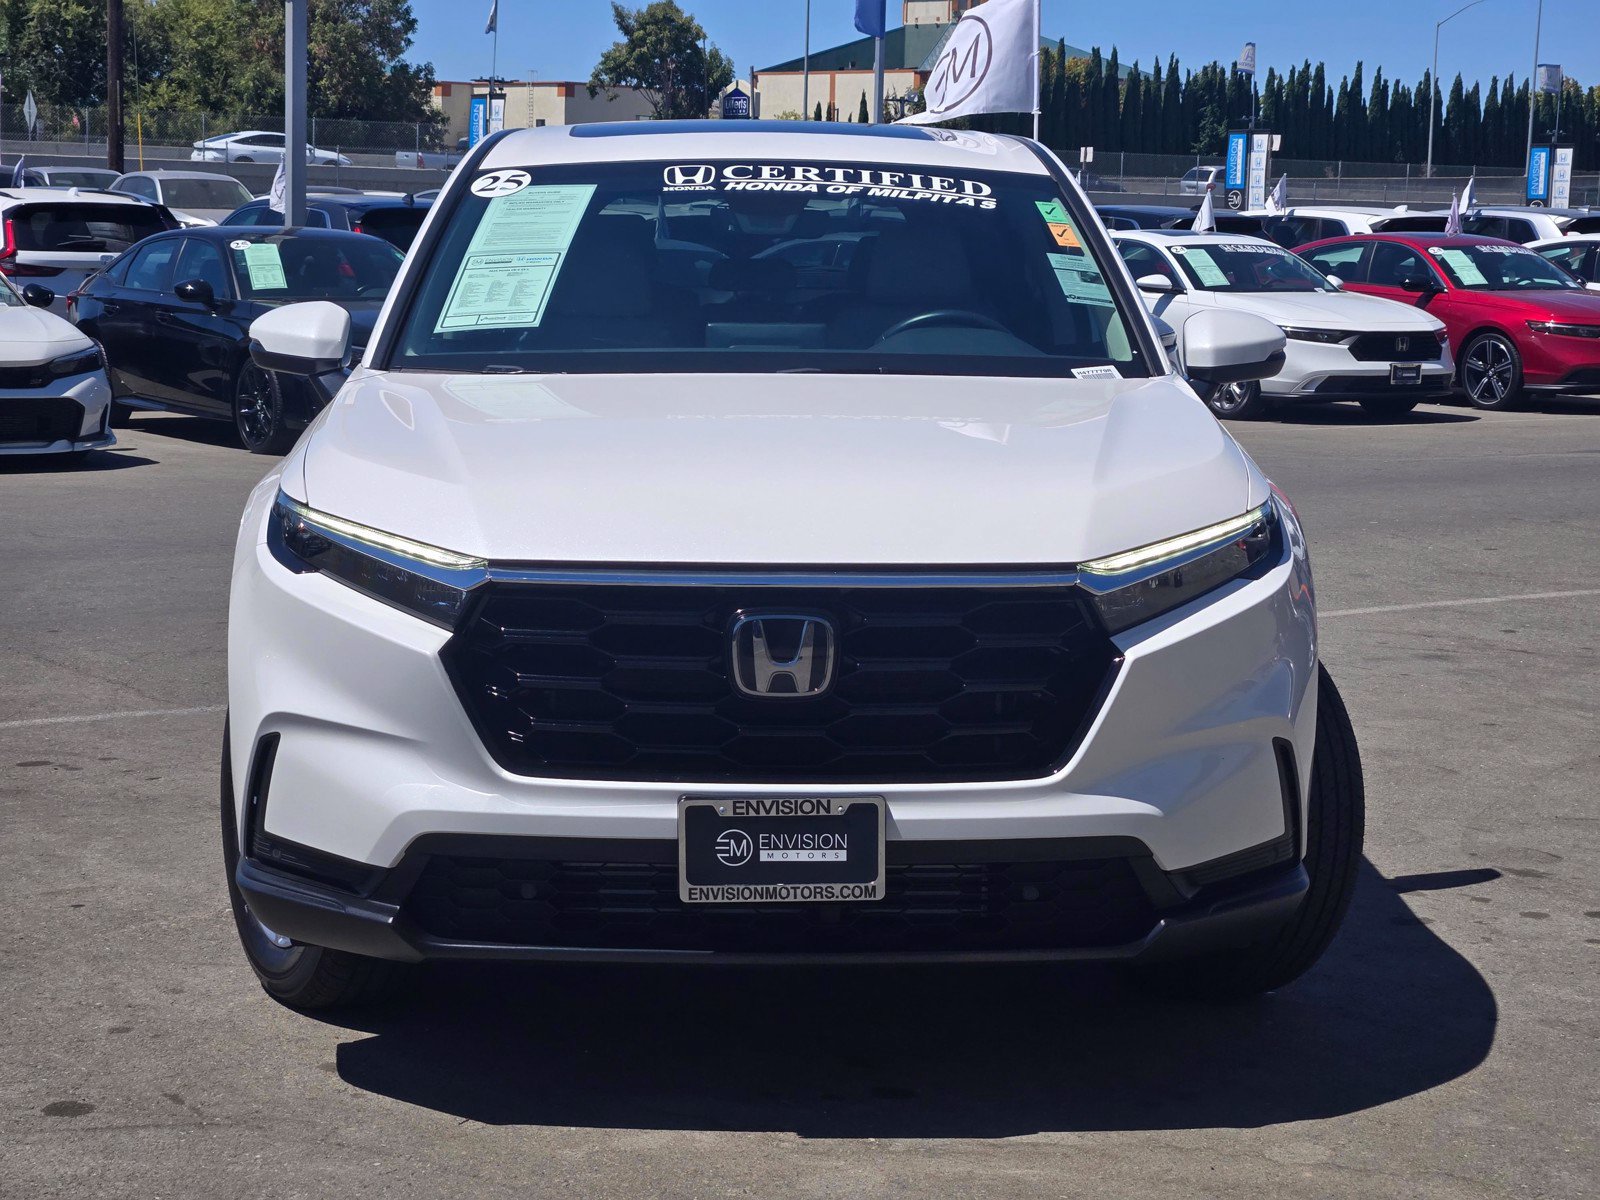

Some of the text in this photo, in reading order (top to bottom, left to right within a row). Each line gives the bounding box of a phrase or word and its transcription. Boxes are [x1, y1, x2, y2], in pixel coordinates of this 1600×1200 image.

[1230, 138, 1238, 184] ENVISION
[475, 173, 528, 193] 25
[722, 165, 992, 196] CERTIFIED
[1530, 152, 1541, 195] ENVISION
[724, 181, 997, 210] HONDA OF MILPITAS
[732, 799, 831, 816] ENVISION
[759, 833, 848, 850] ENVISION
[688, 885, 877, 901] ENVISIONMOTORS.COM
